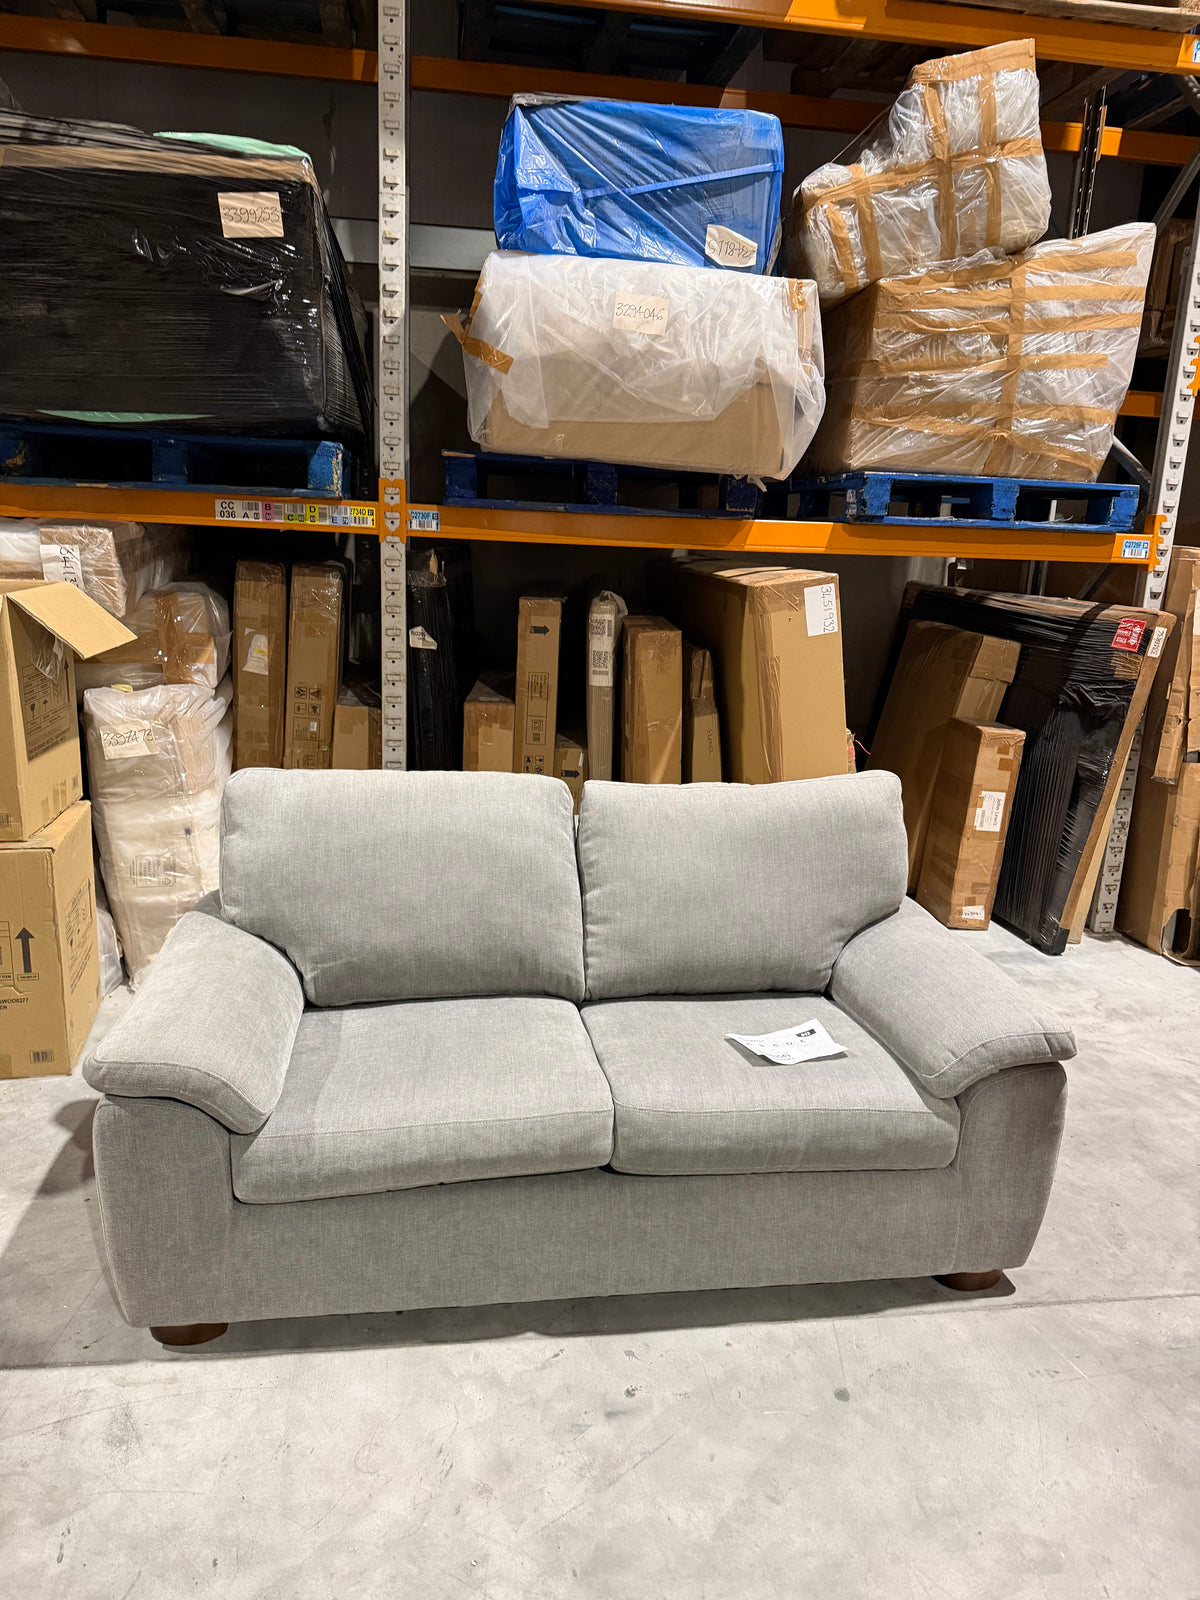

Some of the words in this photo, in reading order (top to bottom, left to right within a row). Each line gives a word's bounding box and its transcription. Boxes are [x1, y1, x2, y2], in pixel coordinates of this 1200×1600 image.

[220, 501, 234, 509] CC
[220, 510, 236, 518] 036
[821, 586, 836, 633] 3451932
